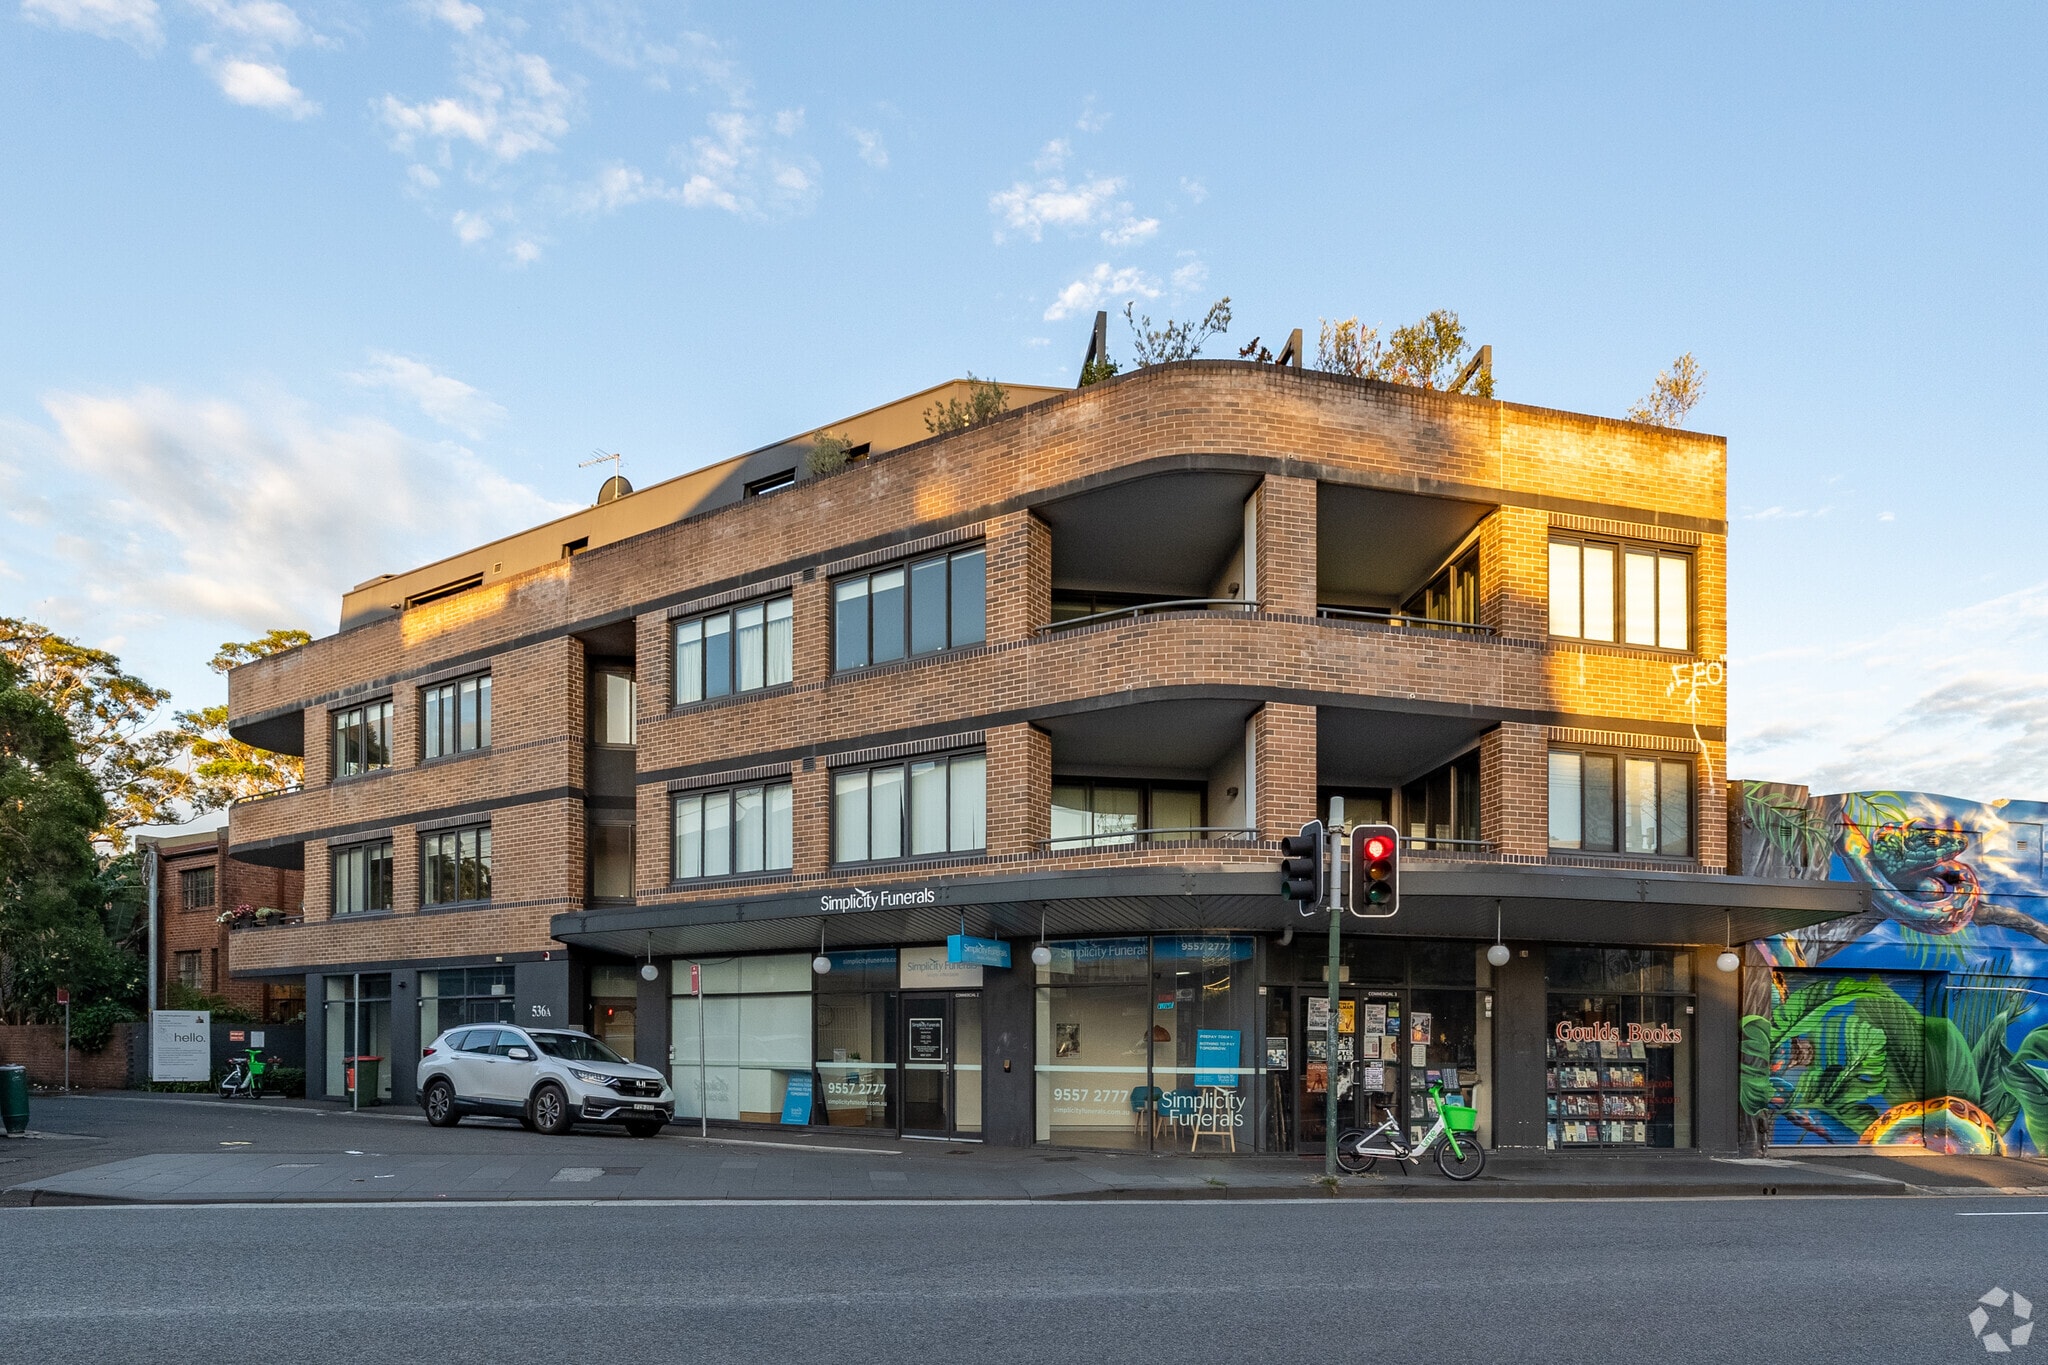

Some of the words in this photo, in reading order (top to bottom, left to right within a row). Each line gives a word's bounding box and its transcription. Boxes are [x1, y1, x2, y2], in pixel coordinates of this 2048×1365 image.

[820, 893, 879, 913] Simplicity
[880, 887, 935, 907] Funerals
[1060, 943, 1106, 959] Simplicity
[1181, 942, 1205, 951] 9557
[1207, 942, 1231, 951] 2777
[907, 960, 943, 972] Simplicity
[531, 1004, 552, 1017] 536A
[1556, 1021, 1620, 1042] Goulds
[1626, 1022, 1683, 1044] Books
[828, 1082, 856, 1095] 9557
[858, 1083, 887, 1096] 2777
[1053, 1088, 1089, 1102] 9557
[1093, 1089, 1129, 1103] 2777
[1162, 1091, 1246, 1113] Simplicity
[1053, 1106, 1130, 1116] simplicityfunerals.com.au
[1169, 1109, 1244, 1127] Funerals
